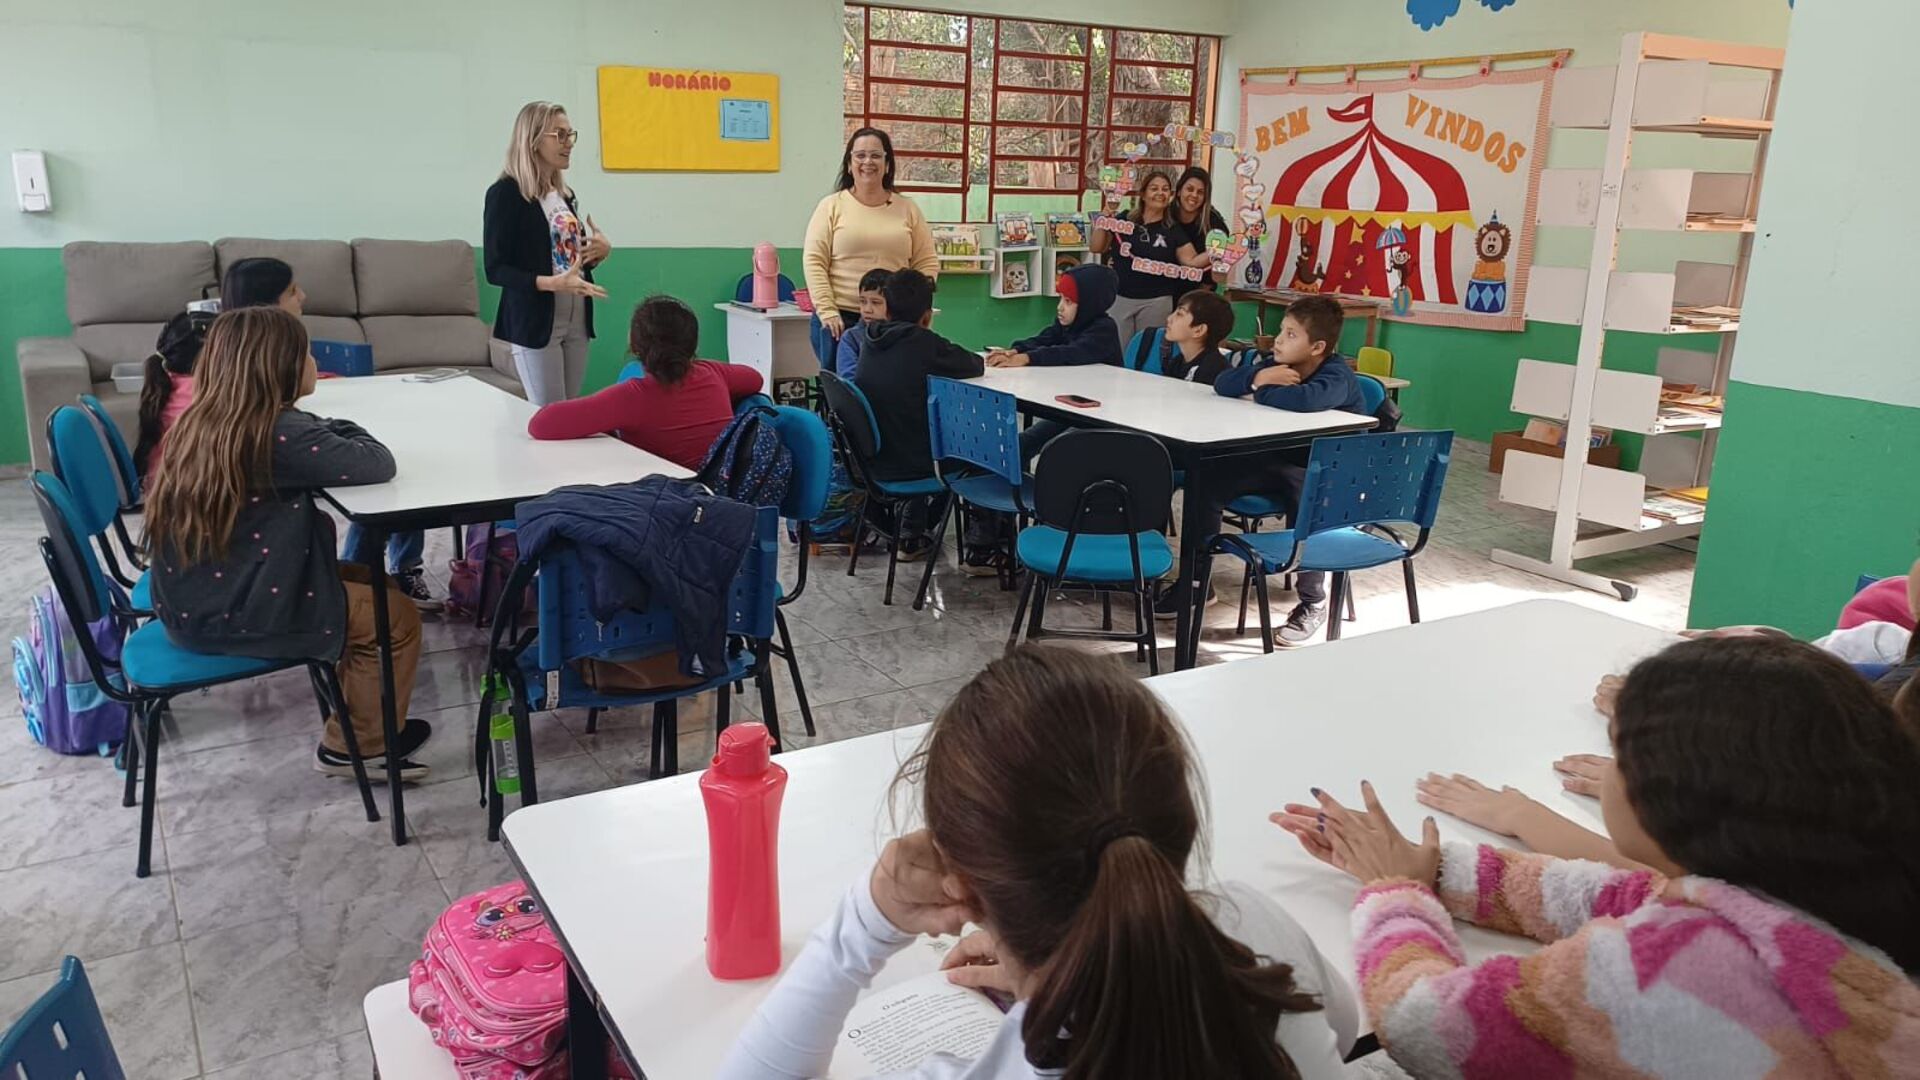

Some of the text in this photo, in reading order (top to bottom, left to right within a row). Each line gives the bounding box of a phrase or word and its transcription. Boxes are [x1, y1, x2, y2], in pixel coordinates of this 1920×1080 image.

[648, 70, 732, 92] HORÁRIO
[1255, 93, 1527, 174] BEM VINDOS
[1095, 216, 1135, 235] AMOR
[1120, 242, 1131, 257] E
[1132, 258, 1203, 282] RESPEITO!
